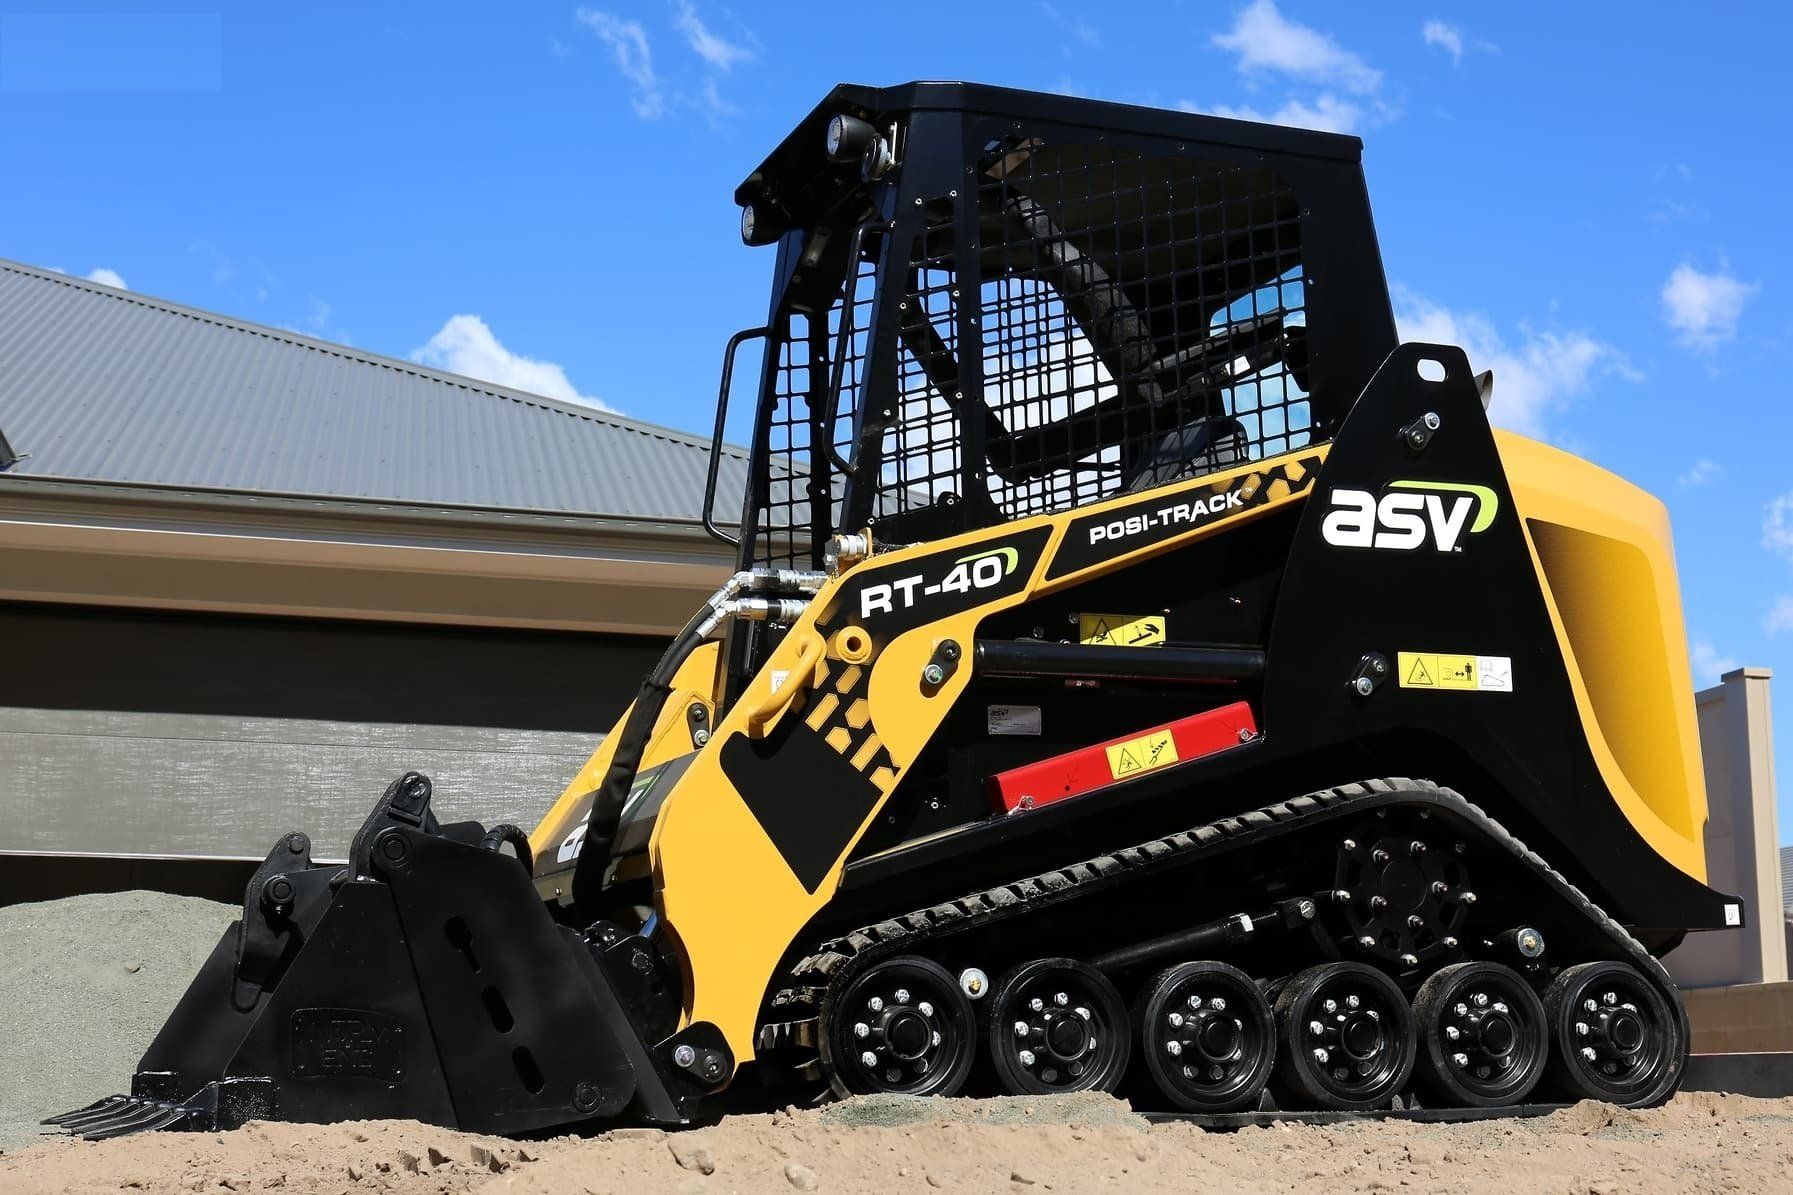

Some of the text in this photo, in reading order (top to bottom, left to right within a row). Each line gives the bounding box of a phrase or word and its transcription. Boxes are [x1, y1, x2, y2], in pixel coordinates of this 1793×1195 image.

[1089, 489, 1244, 545] POSI-TRACK
[1322, 488, 1474, 552] asv
[860, 556, 1002, 619] RT-40
